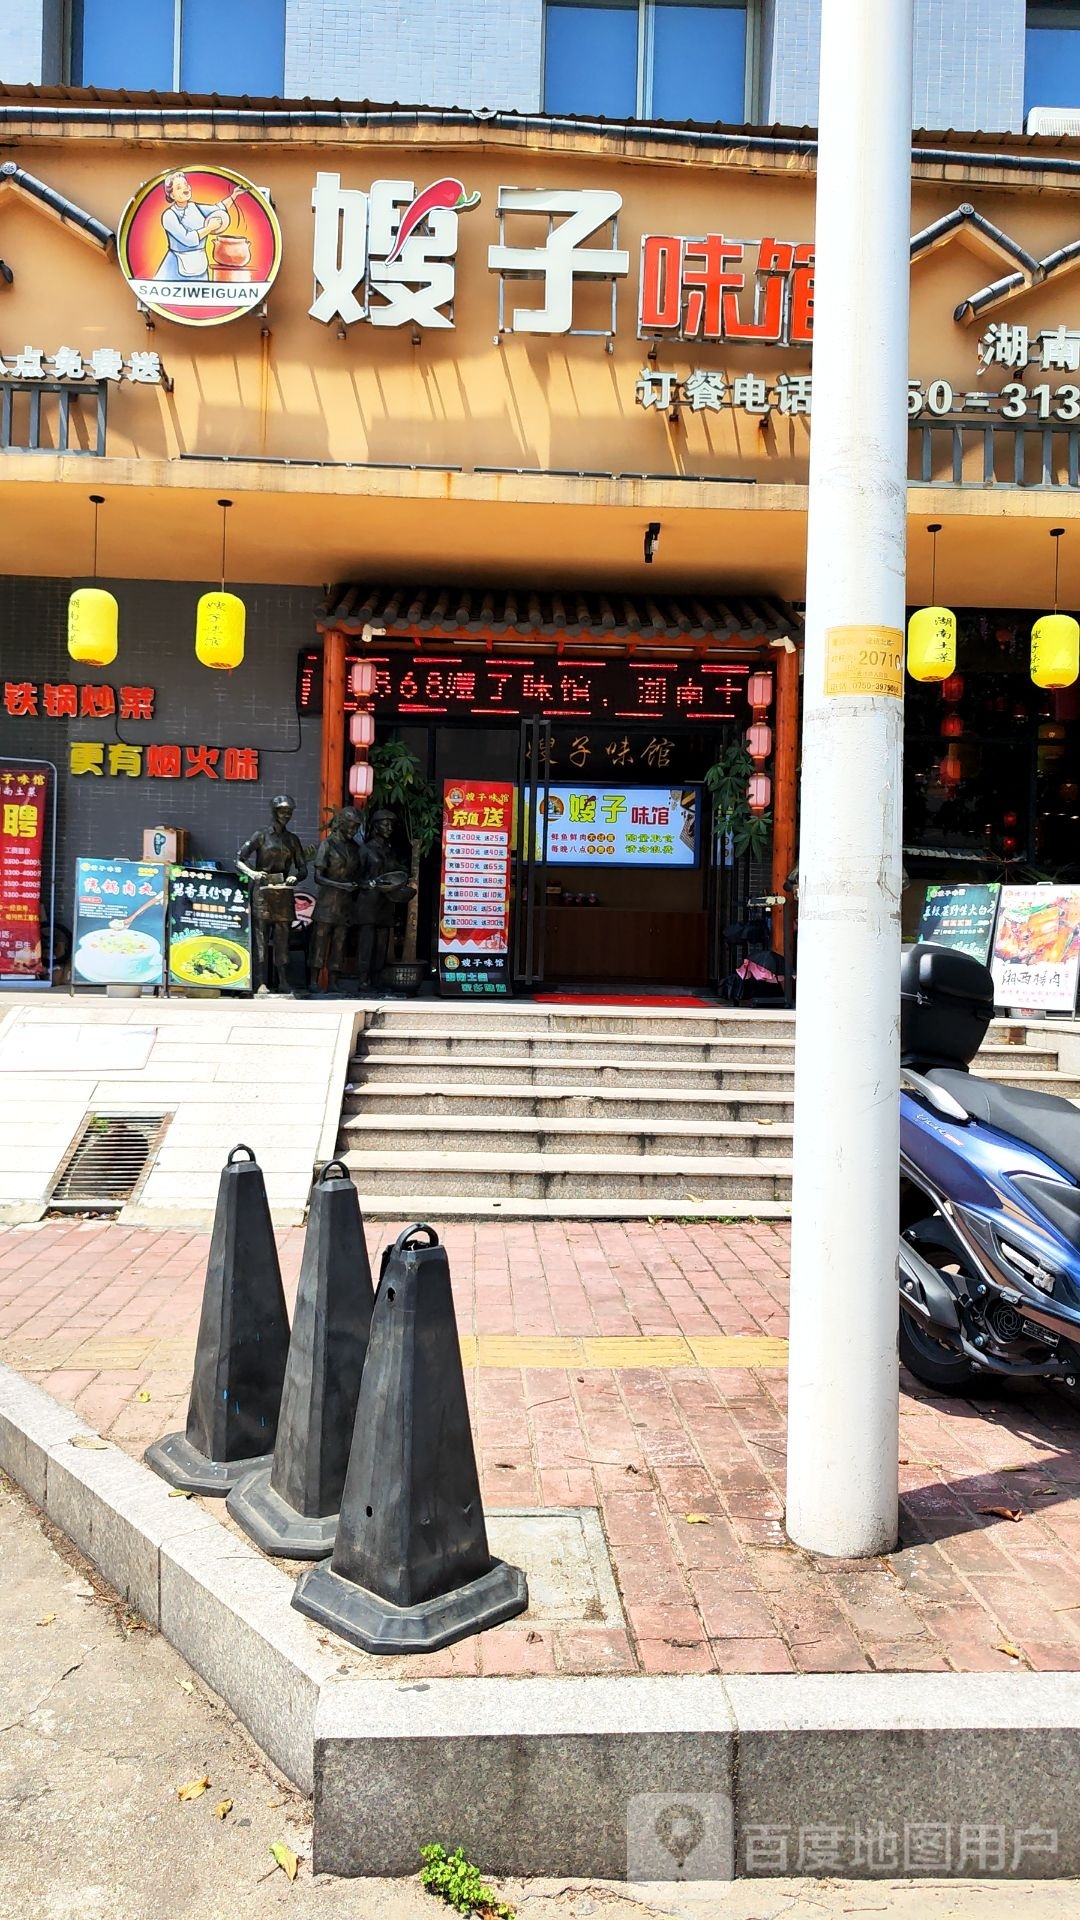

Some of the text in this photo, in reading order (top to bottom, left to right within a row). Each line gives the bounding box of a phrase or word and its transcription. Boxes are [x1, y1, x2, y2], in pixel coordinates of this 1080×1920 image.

[138, 285, 259, 299] SAOZIWEIGUAN
[0, 345, 162, 384] 点免费送
[637, 369, 813, 415] 订餐电话
[4, 682, 155, 719] 铁锅炒菜
[70, 741, 259, 780] 更有烟火味
[0, 785, 38, 797] 南土菜
[465, 792, 509, 804] 嫂子味馆
[3, 803, 38, 838] 聘
[451, 806, 504, 828] 充值送
[449, 833, 505, 844] 充值200元 送25元
[449, 847, 504, 858] 充值300元 送40元
[448, 862, 503, 872] 充值500元 送65元
